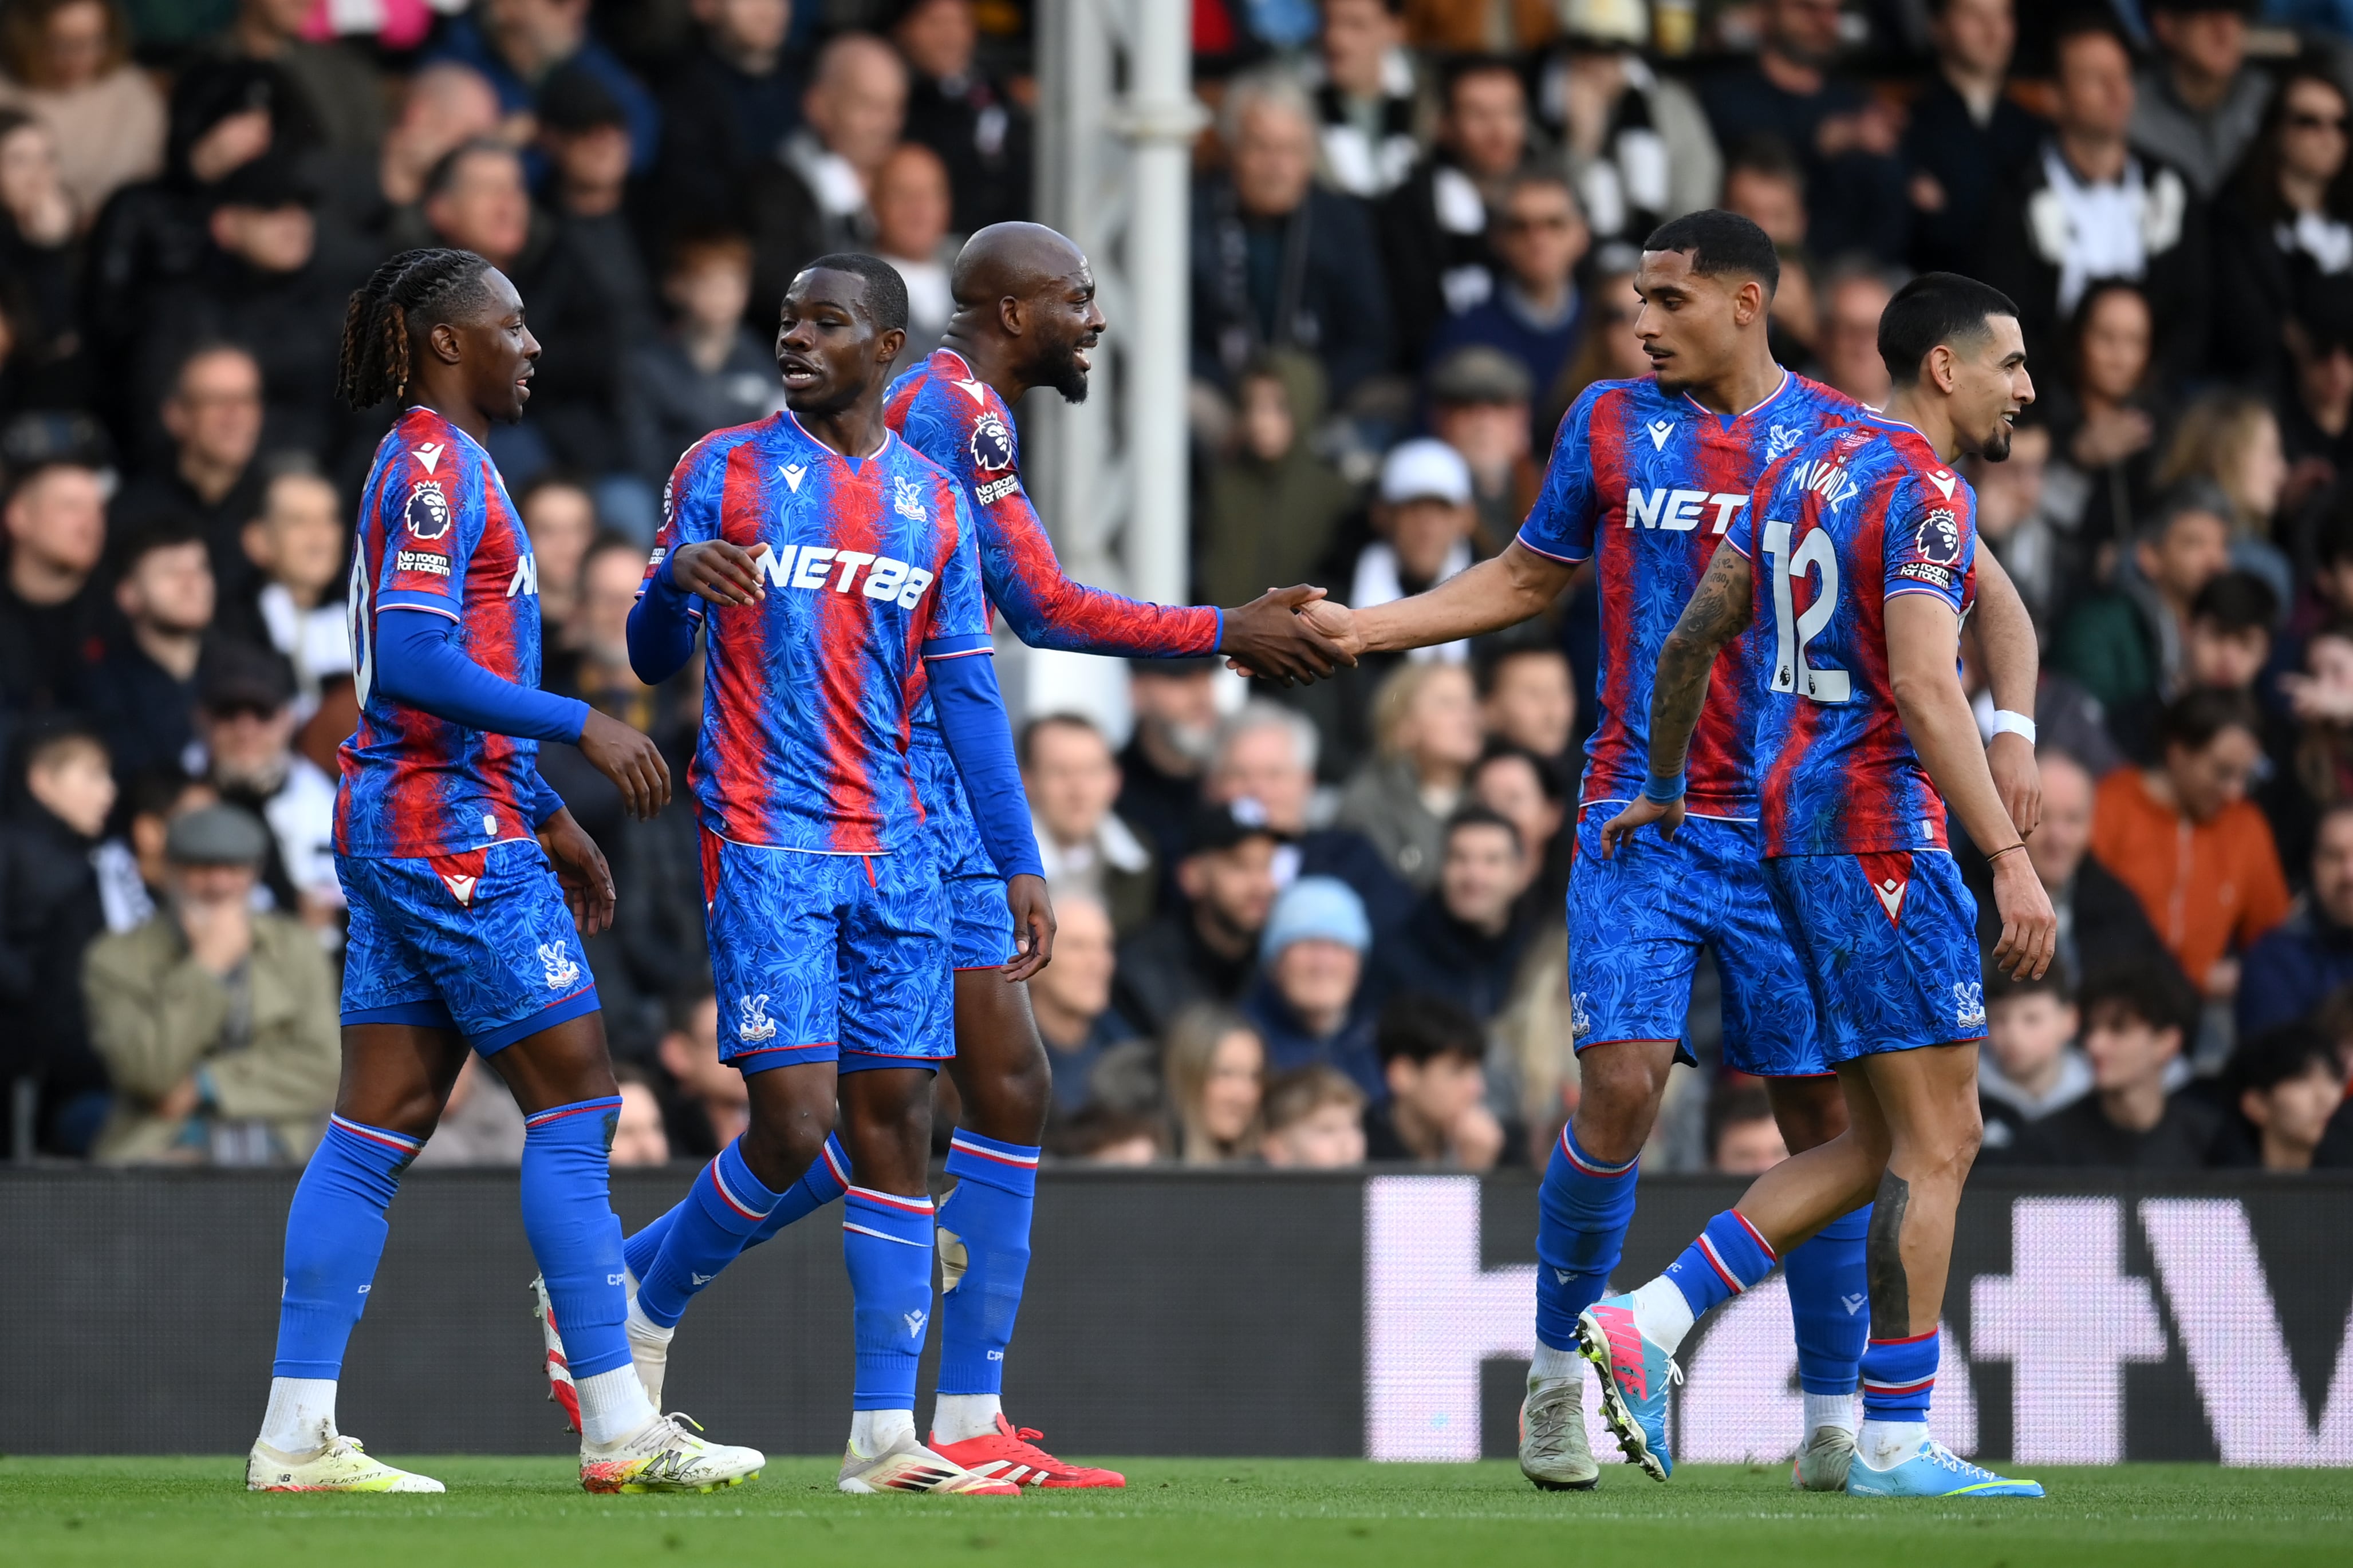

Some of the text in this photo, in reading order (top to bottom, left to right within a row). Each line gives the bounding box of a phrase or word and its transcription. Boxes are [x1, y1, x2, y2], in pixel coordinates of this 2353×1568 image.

[975, 474, 1015, 496] No room
[995, 481, 1019, 499] racism
[397, 551, 447, 566] No room
[414, 562, 450, 576] racism
[506, 553, 538, 597] N
[752, 544, 933, 610] NET88
[1920, 563, 1949, 579] room
[1918, 570, 1948, 589] racism
[1762, 520, 1850, 701] 12
[608, 1272, 625, 1286] CP
